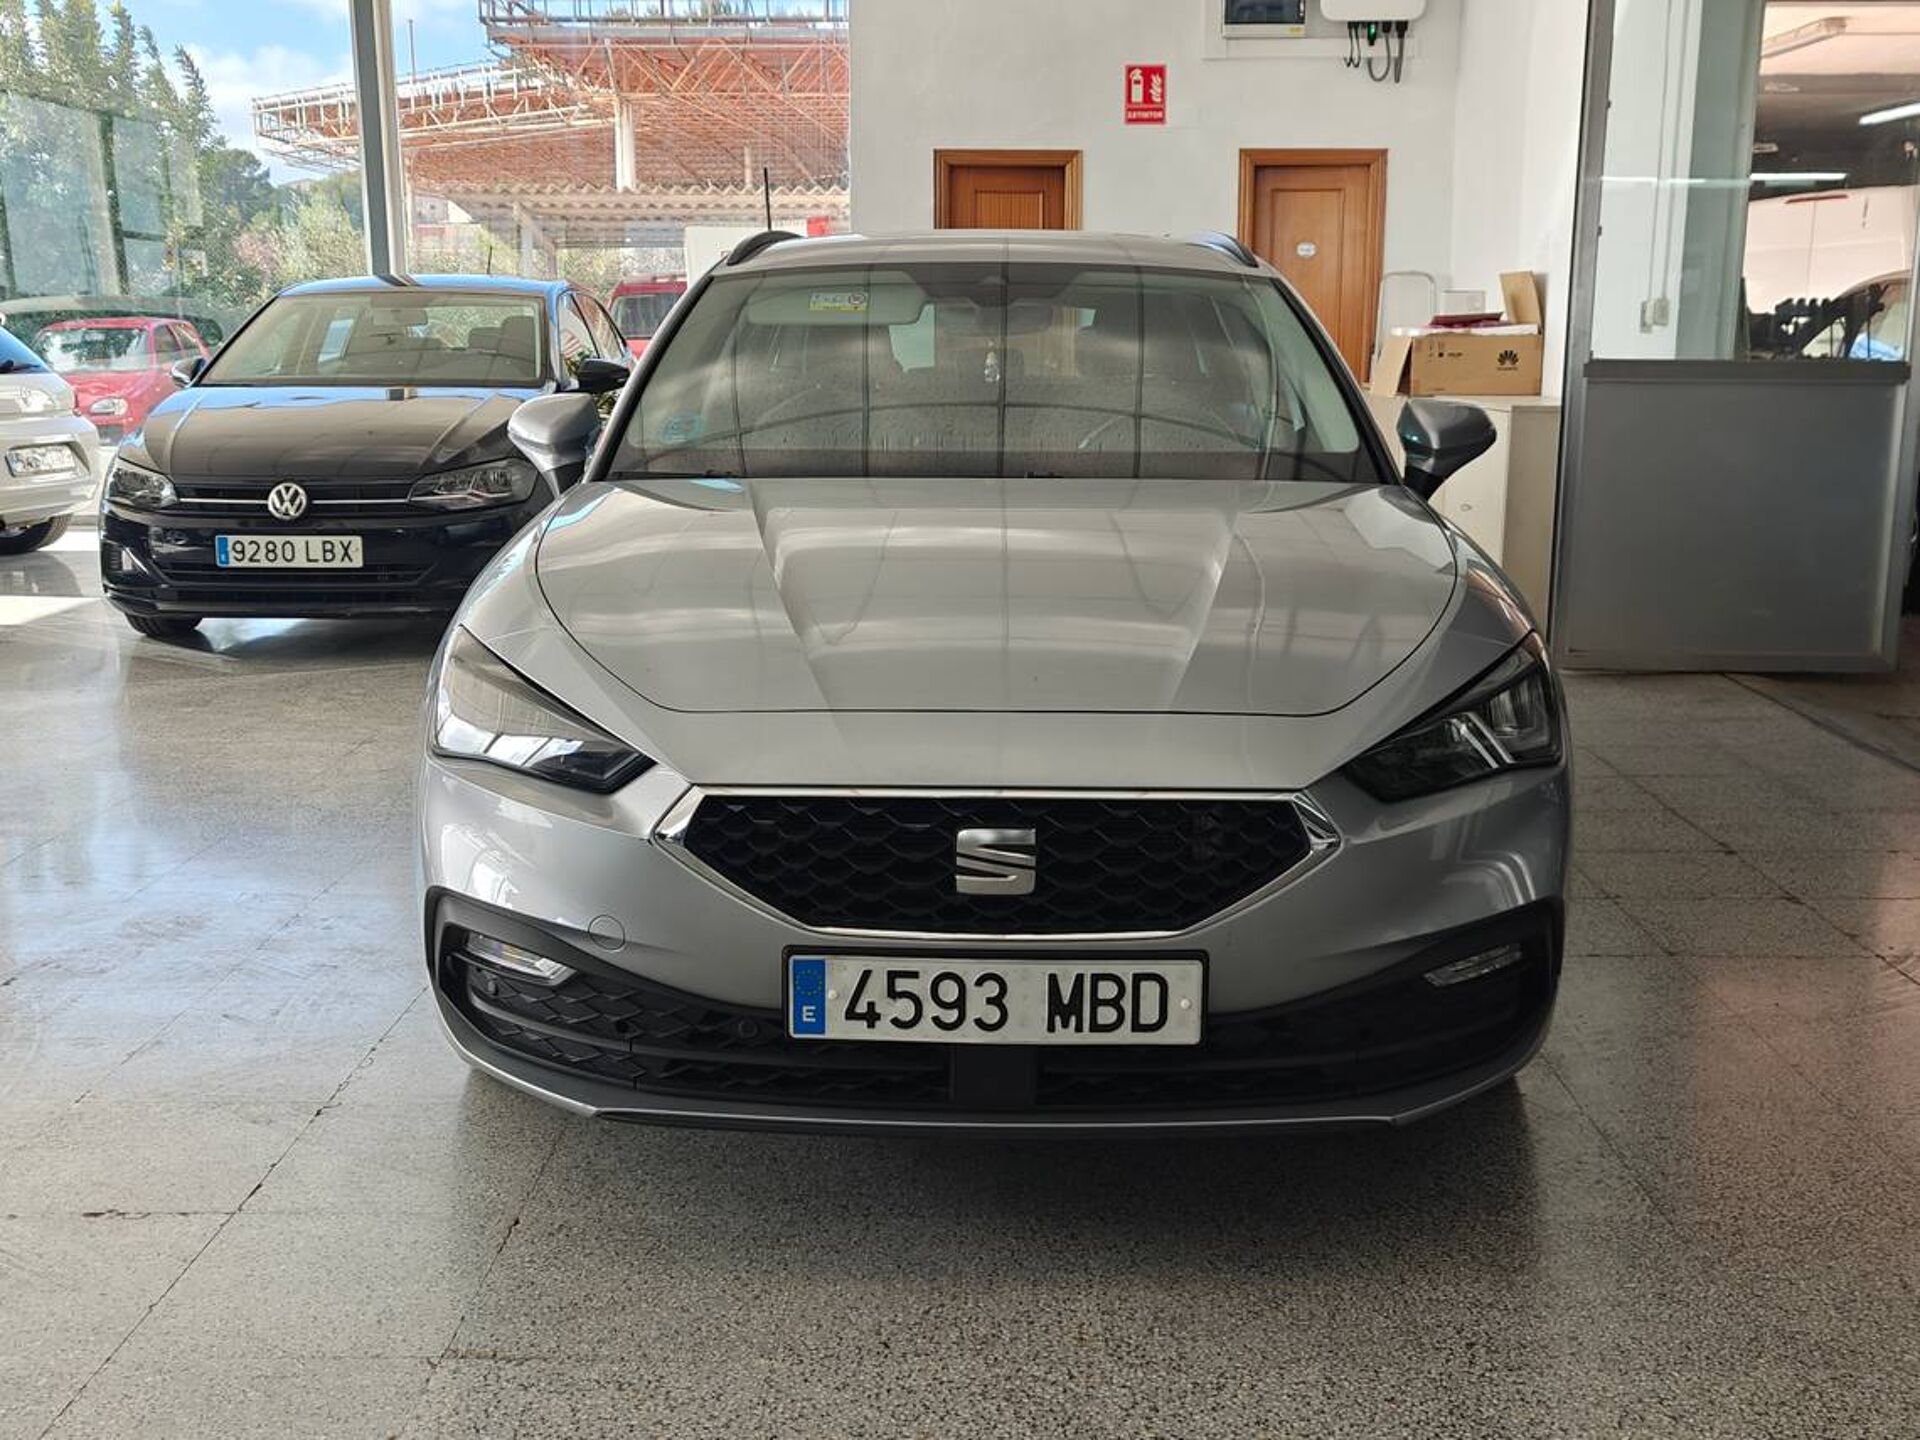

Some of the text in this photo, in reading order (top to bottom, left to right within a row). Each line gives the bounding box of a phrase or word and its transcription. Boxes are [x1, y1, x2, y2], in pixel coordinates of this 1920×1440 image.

[232, 540, 353, 563] 9280 LBX
[802, 969, 1169, 1033] E 4593 MBD
